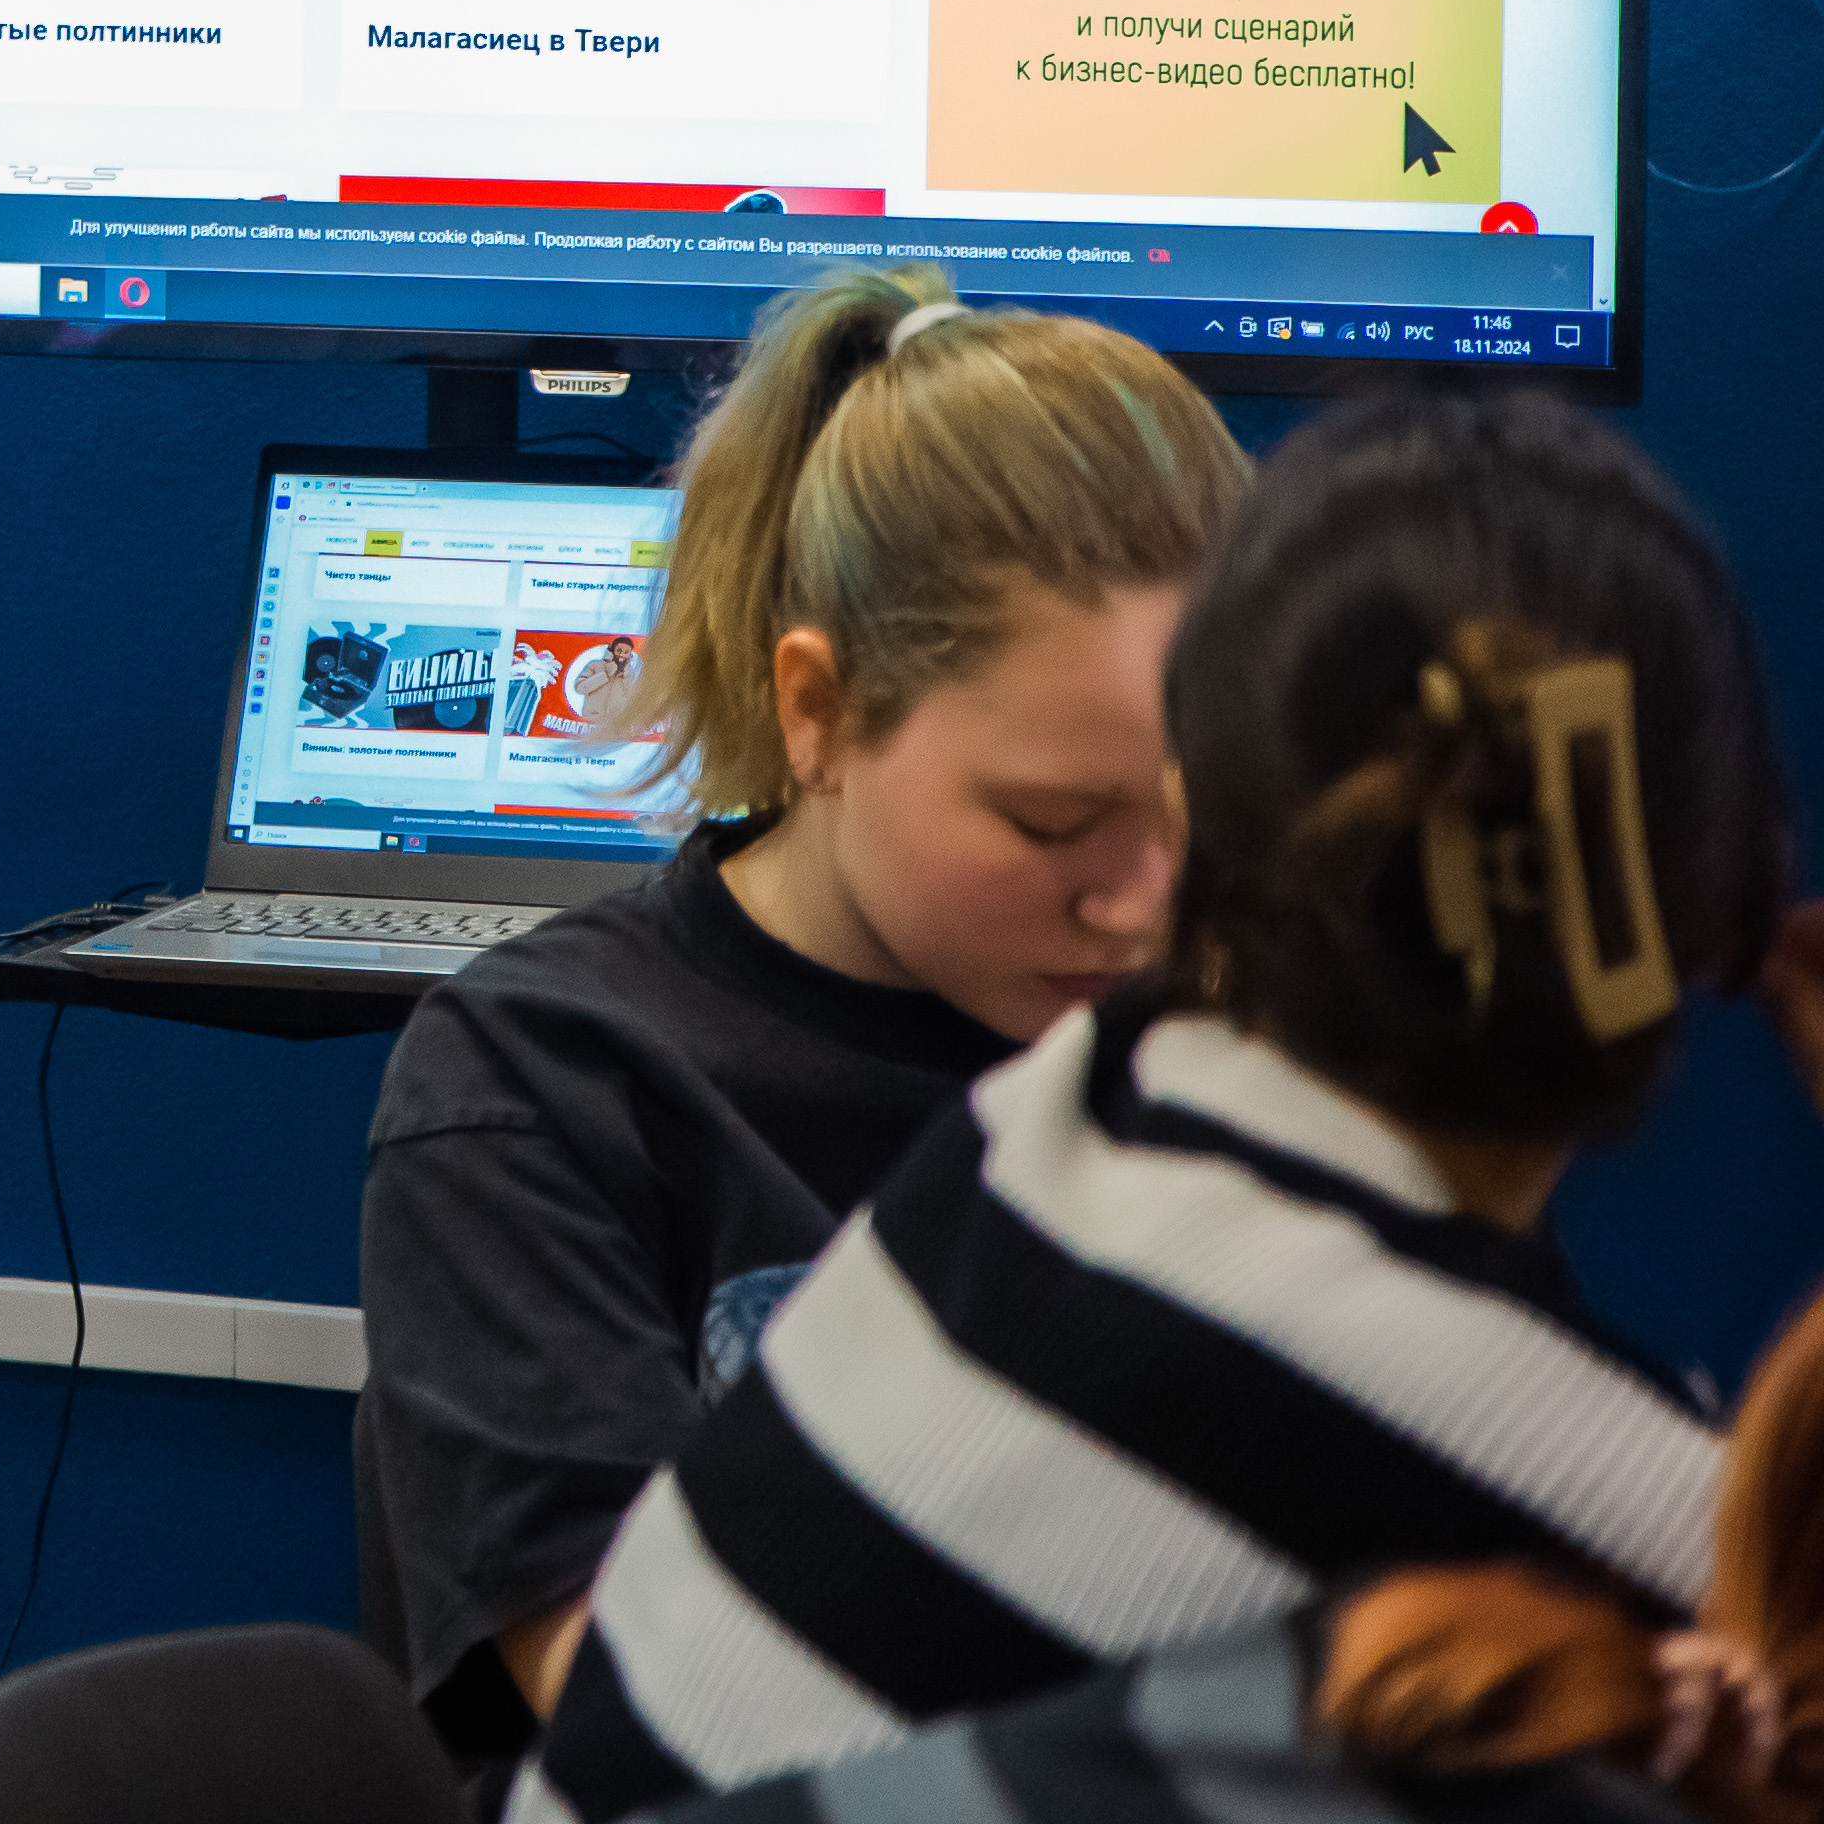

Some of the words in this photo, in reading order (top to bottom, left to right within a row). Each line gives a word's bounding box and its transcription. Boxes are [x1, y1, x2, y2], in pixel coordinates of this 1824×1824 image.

[56, 24, 222, 44] полтинники
[1077, 15, 1093, 37] и
[1104, 15, 1203, 46] получи
[1214, 13, 1354, 47] сценарий
[367, 25, 540, 55] Малагасиец
[551, 36, 565, 51] в
[575, 29, 659, 57] Твери
[1016, 60, 1031, 81] к
[1042, 54, 1243, 88] бизнес-видео
[1254, 58, 1415, 91] бесплатно!
[69, 219, 100, 236] Для
[104, 222, 187, 238] улучшения
[190, 223, 247, 240] работы
[250, 224, 294, 239] сайта
[298, 228, 321, 239] мы
[325, 229, 415, 244] используем
[418, 229, 467, 244] cookie
[471, 231, 530, 248] файлы.
[535, 232, 623, 249] Продолжая
[627, 233, 681, 253] работу
[685, 239, 694, 251] с
[698, 236, 754, 252] сайтом
[758, 238, 782, 253] Вы
[787, 242, 882, 259] разрешаете
[886, 245, 1007, 260] использование
[1011, 246, 1062, 261] cookie
[1066, 248, 1134, 265] файлов.
[1405, 325, 1434, 341] РУС
[1474, 316, 1512, 330] 11:46
[1454, 339, 1532, 355] 18.11.2024
[548, 379, 611, 393] PHILIPS
